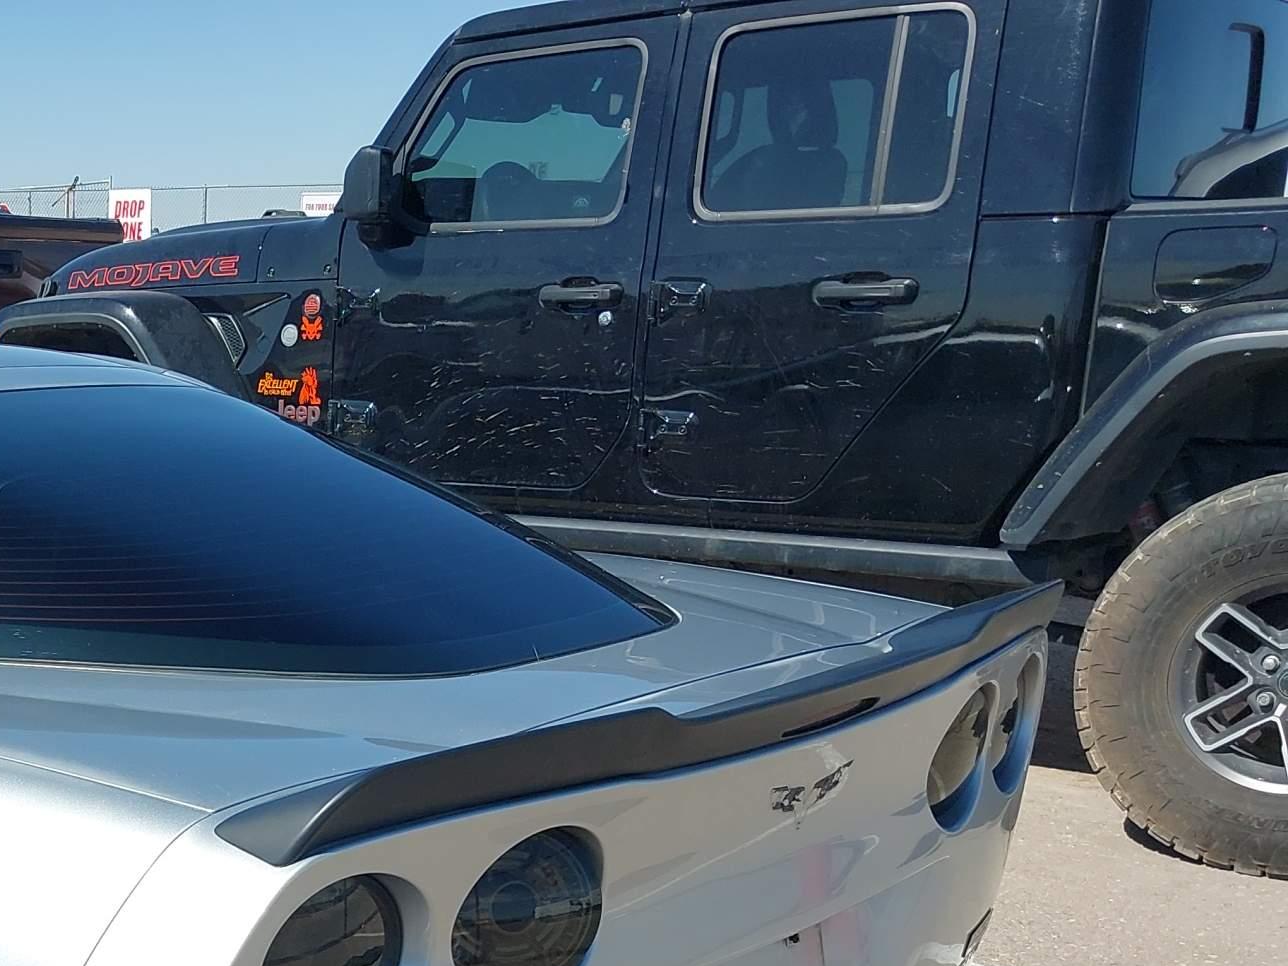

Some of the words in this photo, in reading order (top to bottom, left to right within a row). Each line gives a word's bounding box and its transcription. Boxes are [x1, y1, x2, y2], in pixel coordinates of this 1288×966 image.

[115, 200, 145, 219] DROP
[122, 221, 143, 241] ONE
[68, 255, 240, 289] MOJAVE
[257, 379, 299, 393] EXCELLENT
[278, 399, 321, 426] Jeep
